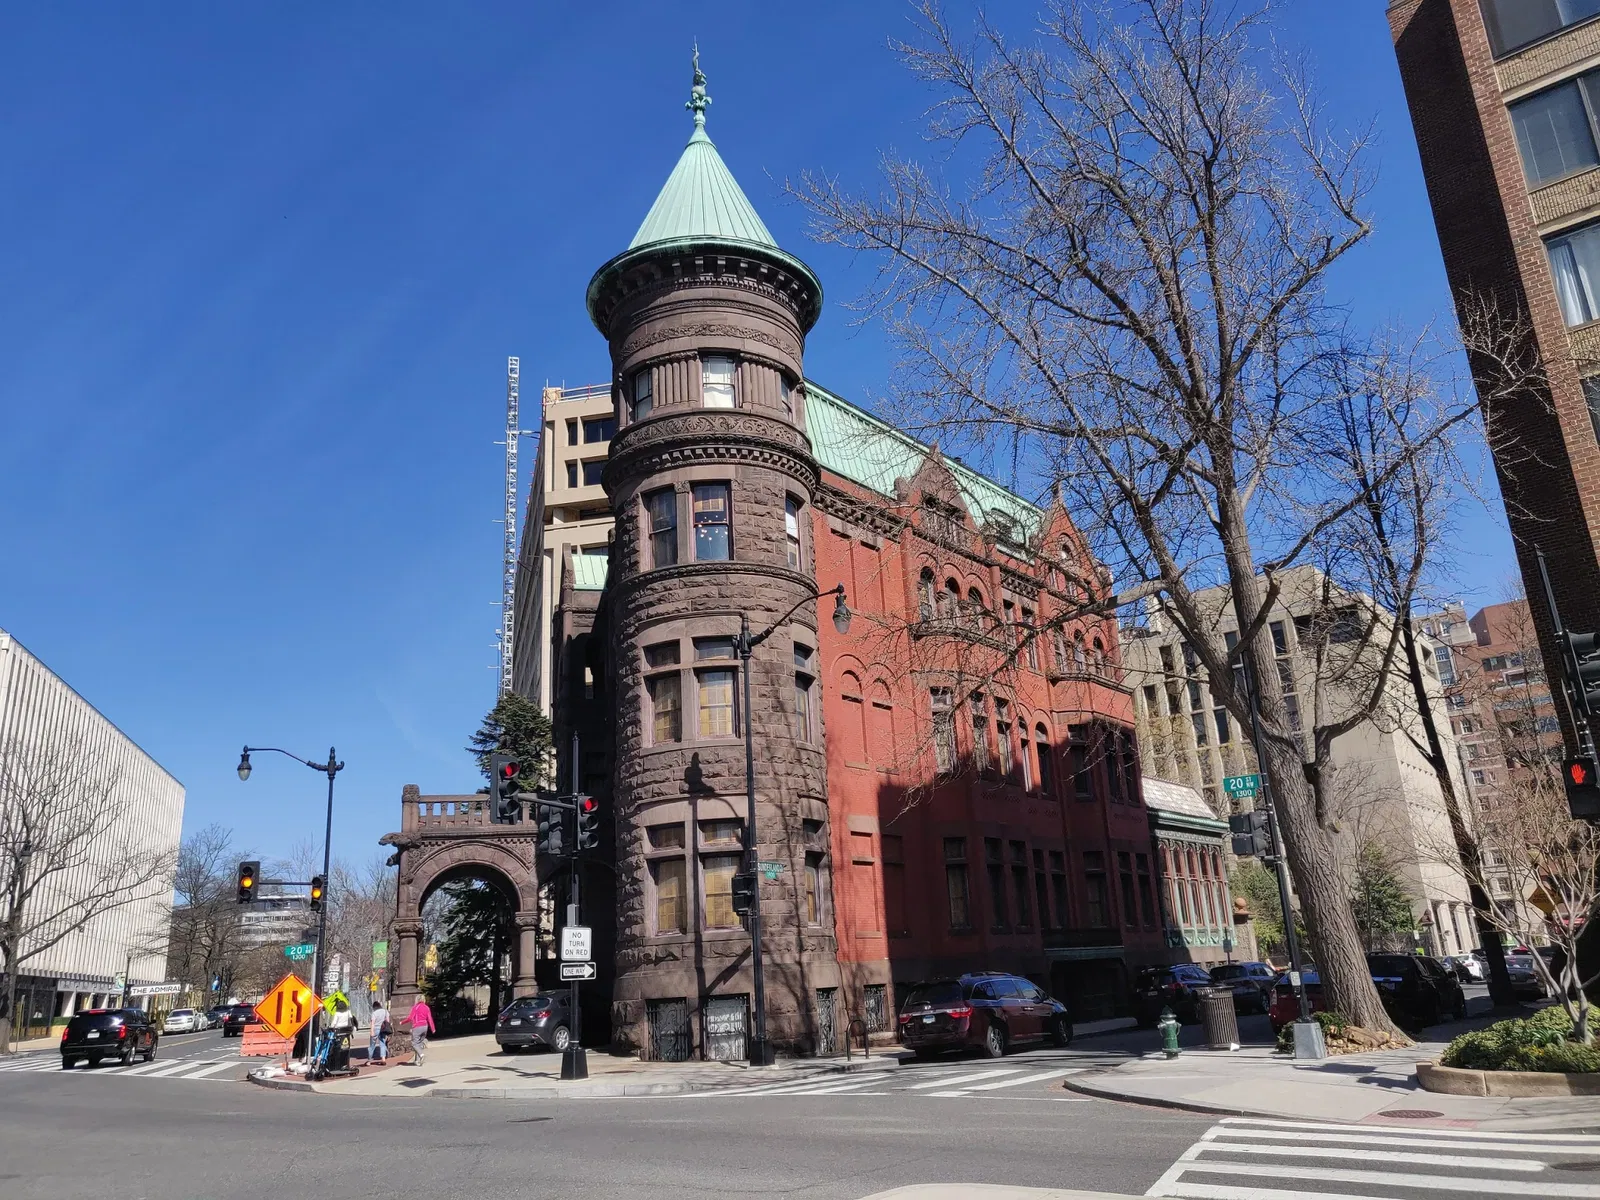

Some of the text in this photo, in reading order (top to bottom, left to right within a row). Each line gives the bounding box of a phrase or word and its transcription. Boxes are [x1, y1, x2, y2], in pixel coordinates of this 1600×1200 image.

[1230, 778, 1243, 789] 20
[1236, 790, 1252, 798] 1300
[290, 946, 302, 955] 20
[149, 985, 180, 993] ADMIRAL
